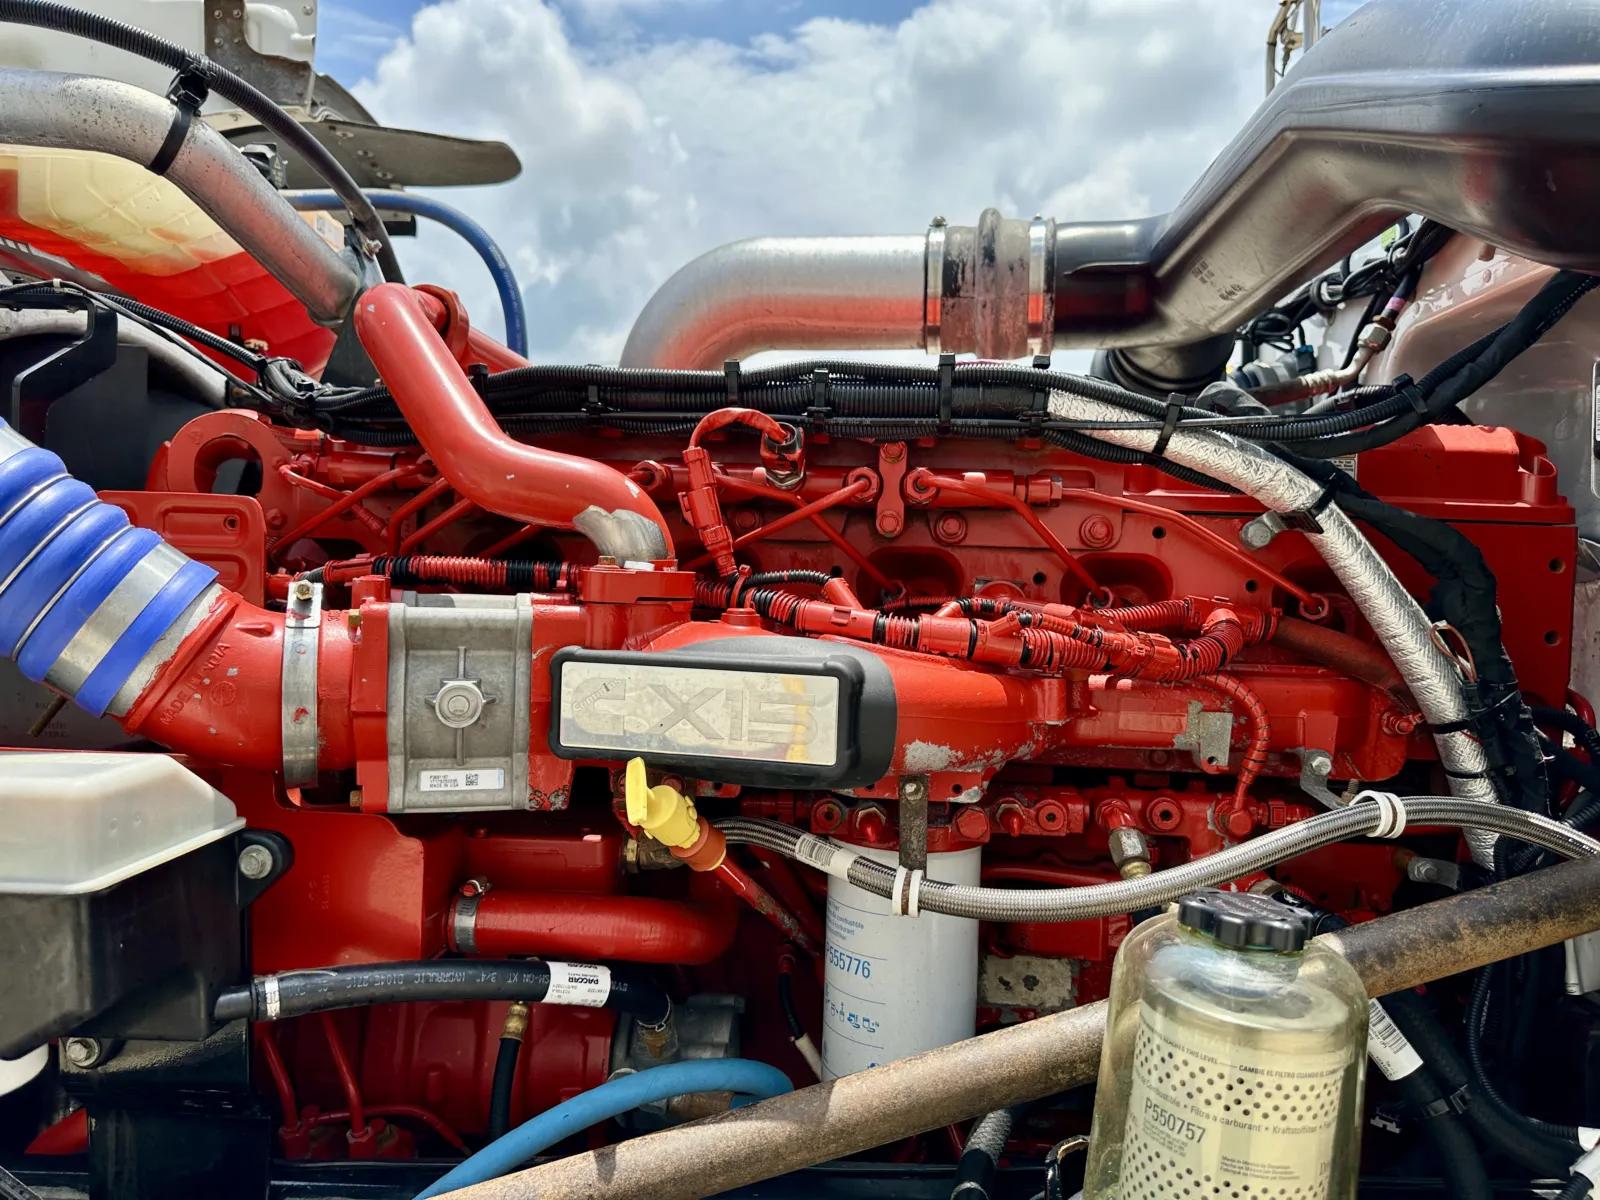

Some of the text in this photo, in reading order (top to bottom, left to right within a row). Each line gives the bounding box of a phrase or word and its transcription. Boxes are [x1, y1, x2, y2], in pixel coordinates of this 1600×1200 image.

[160, 690, 191, 725] MADE
[568, 976, 599, 985] PACCAR
[1144, 1096, 1206, 1144] P550757
